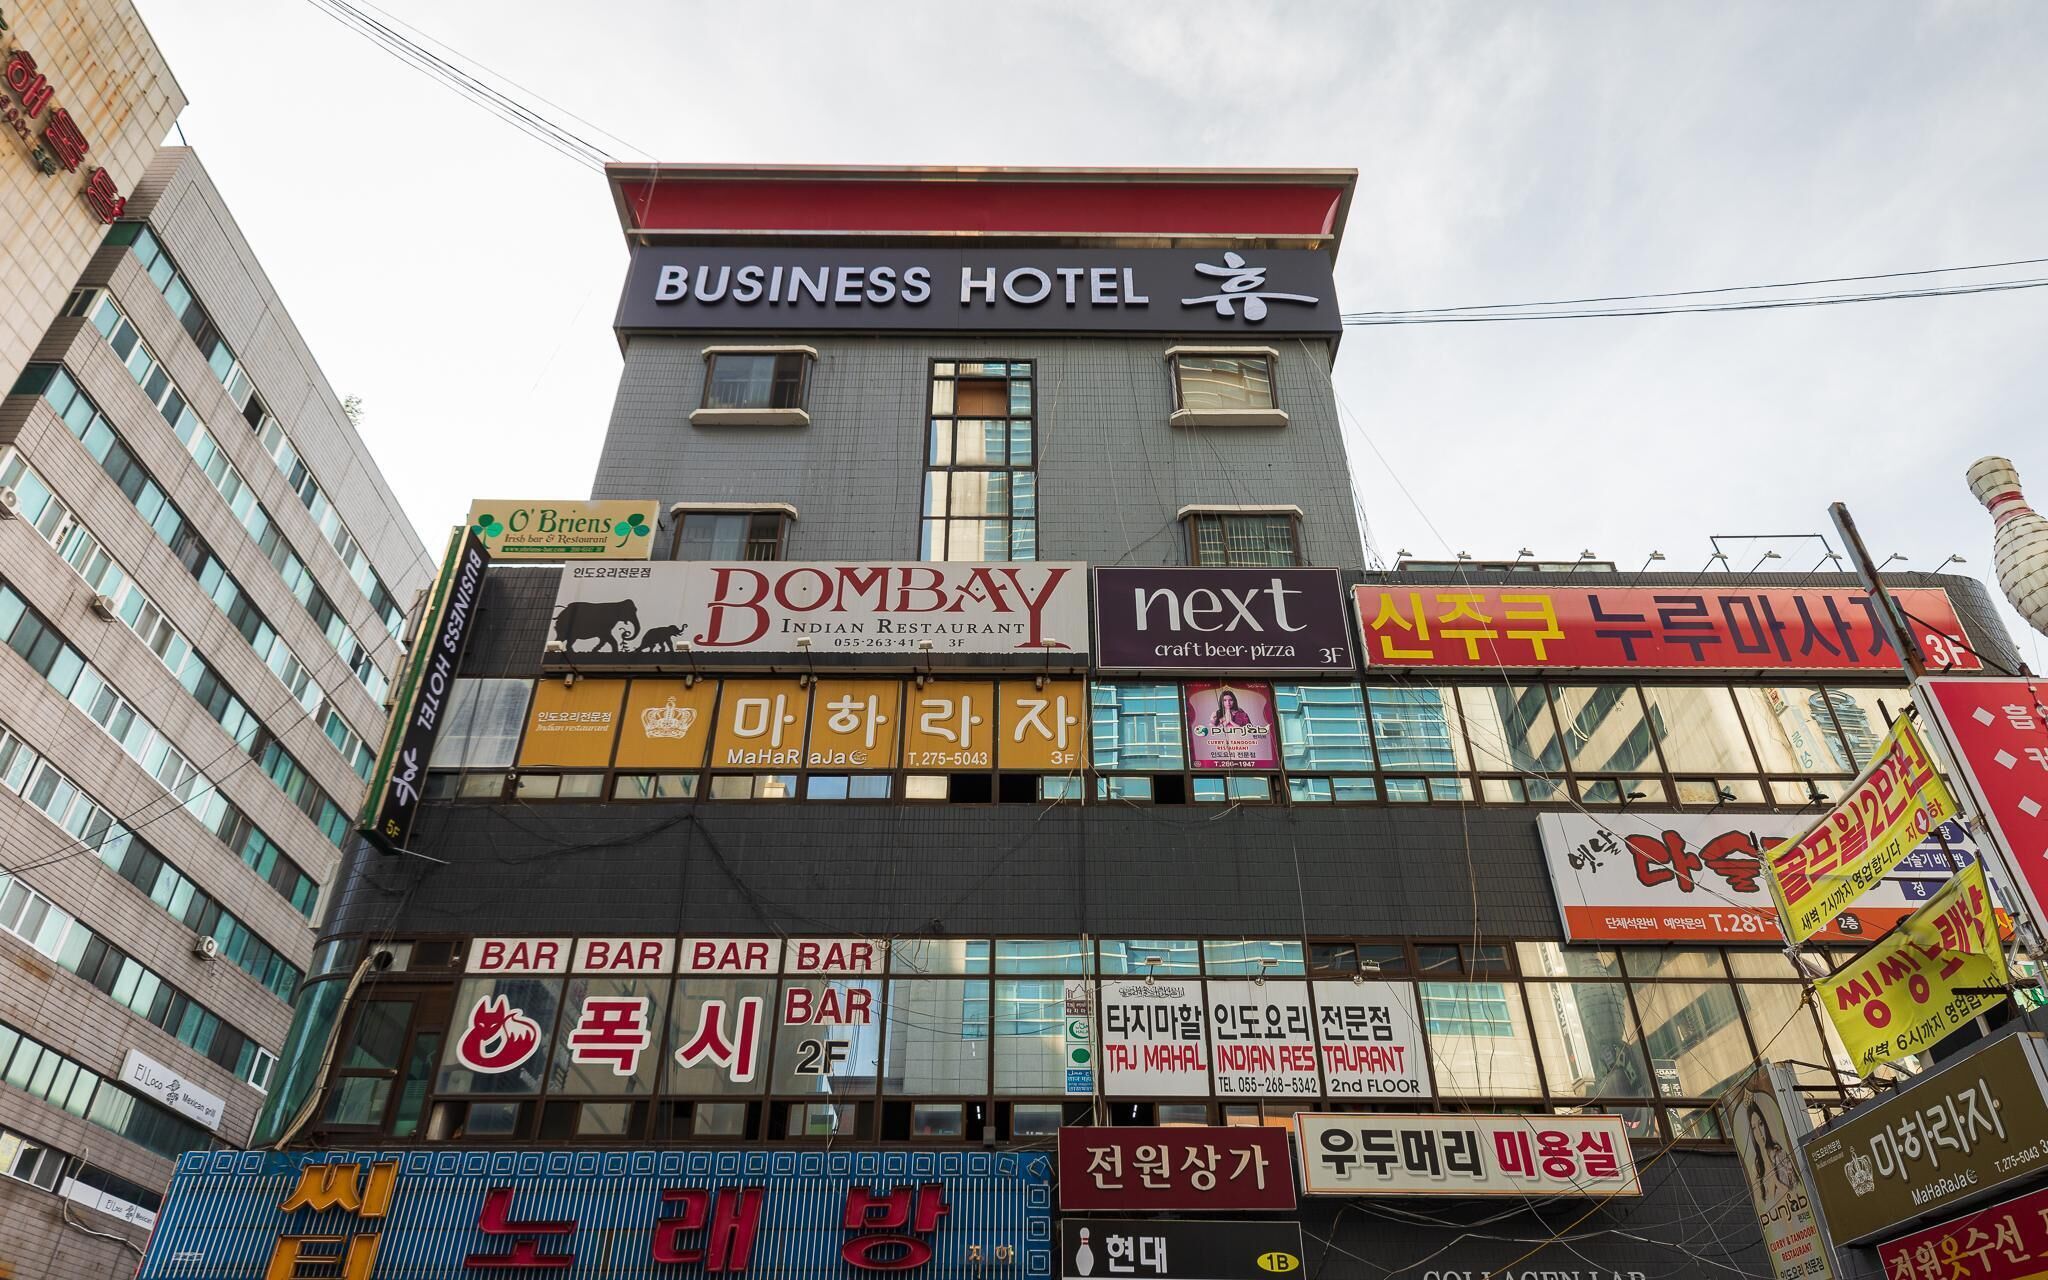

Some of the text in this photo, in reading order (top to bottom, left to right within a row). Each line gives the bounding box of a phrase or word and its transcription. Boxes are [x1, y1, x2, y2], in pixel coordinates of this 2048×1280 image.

[655, 265, 1150, 305] BUSINESS HOTEL
[508, 509, 612, 533] O'Briens
[504, 534, 526, 544] Irish
[527, 534, 545, 544] bar
[557, 534, 609, 544] Restaurant
[573, 567, 651, 579] 인도요리전문점
[694, 567, 1073, 649] BOMBAY
[1134, 578, 1308, 632] next
[416, 549, 482, 731] BUSINESS HOTEL
[780, 617, 1026, 635] INDIAN RESTAURANT
[1370, 591, 1567, 662] 신주쿠
[948, 638, 965, 648] 3F
[1154, 641, 1202, 657] craft
[1318, 647, 1344, 664] 3F
[1925, 634, 1966, 667] 3F
[537, 711, 613, 722] 인도요리전문점
[733, 693, 1079, 749] 마하라자
[1211, 724, 1269, 737] punjab
[908, 751, 988, 767] T.275-5043
[1050, 750, 1074, 765] 3F
[386, 819, 401, 838] 5F
[1932, 853, 1967, 868] 비밥
[1801, 838, 1902, 932] 새벽 7시까지 영업합니다
[1604, 916, 1659, 930] 단체석완비
[1663, 917, 1707, 930] 예약문의
[1837, 916, 1860, 931] 2층
[480, 942, 560, 970] BAR
[583, 942, 664, 970] BAR
[691, 942, 770, 970] BAR
[796, 942, 874, 971] BAR
[785, 987, 873, 1025] BAR
[1105, 1003, 1394, 1042] 타지마할 인도요리 전문점
[570, 998, 763, 1080] 폭시
[1863, 1041, 1891, 1066] 새벽
[1896, 1011, 1946, 1051] 6시까지
[796, 1040, 850, 1075] 2F
[1105, 1042, 1406, 1075] TAJ MAHAL INDIAN RES TAURANT
[1218, 1076, 1319, 1095] TEL. 055-268-5342
[1331, 1077, 1421, 1095] 2nd FLOOR
[182, 1092, 205, 1112] Mexican
[1869, 1078, 2005, 1182] 마하라자
[1085, 1143, 1270, 1192] 전원상가
[1319, 1127, 1625, 1182] 우두머리 미용실
[1994, 1145, 2041, 1174] T.275-5043
[1760, 1192, 1809, 1231] punjab
[464, 1185, 951, 1273] 노래방
[1769, 1239, 1787, 1253] CURRY
[1790, 1225, 1818, 1244] TANDOORI
[1105, 1233, 1169, 1275] 현대
[1266, 1253, 1290, 1271] 1B
[1781, 1242, 1814, 1262] RESTAURANT
[1804, 1255, 1825, 1275] 전문점
